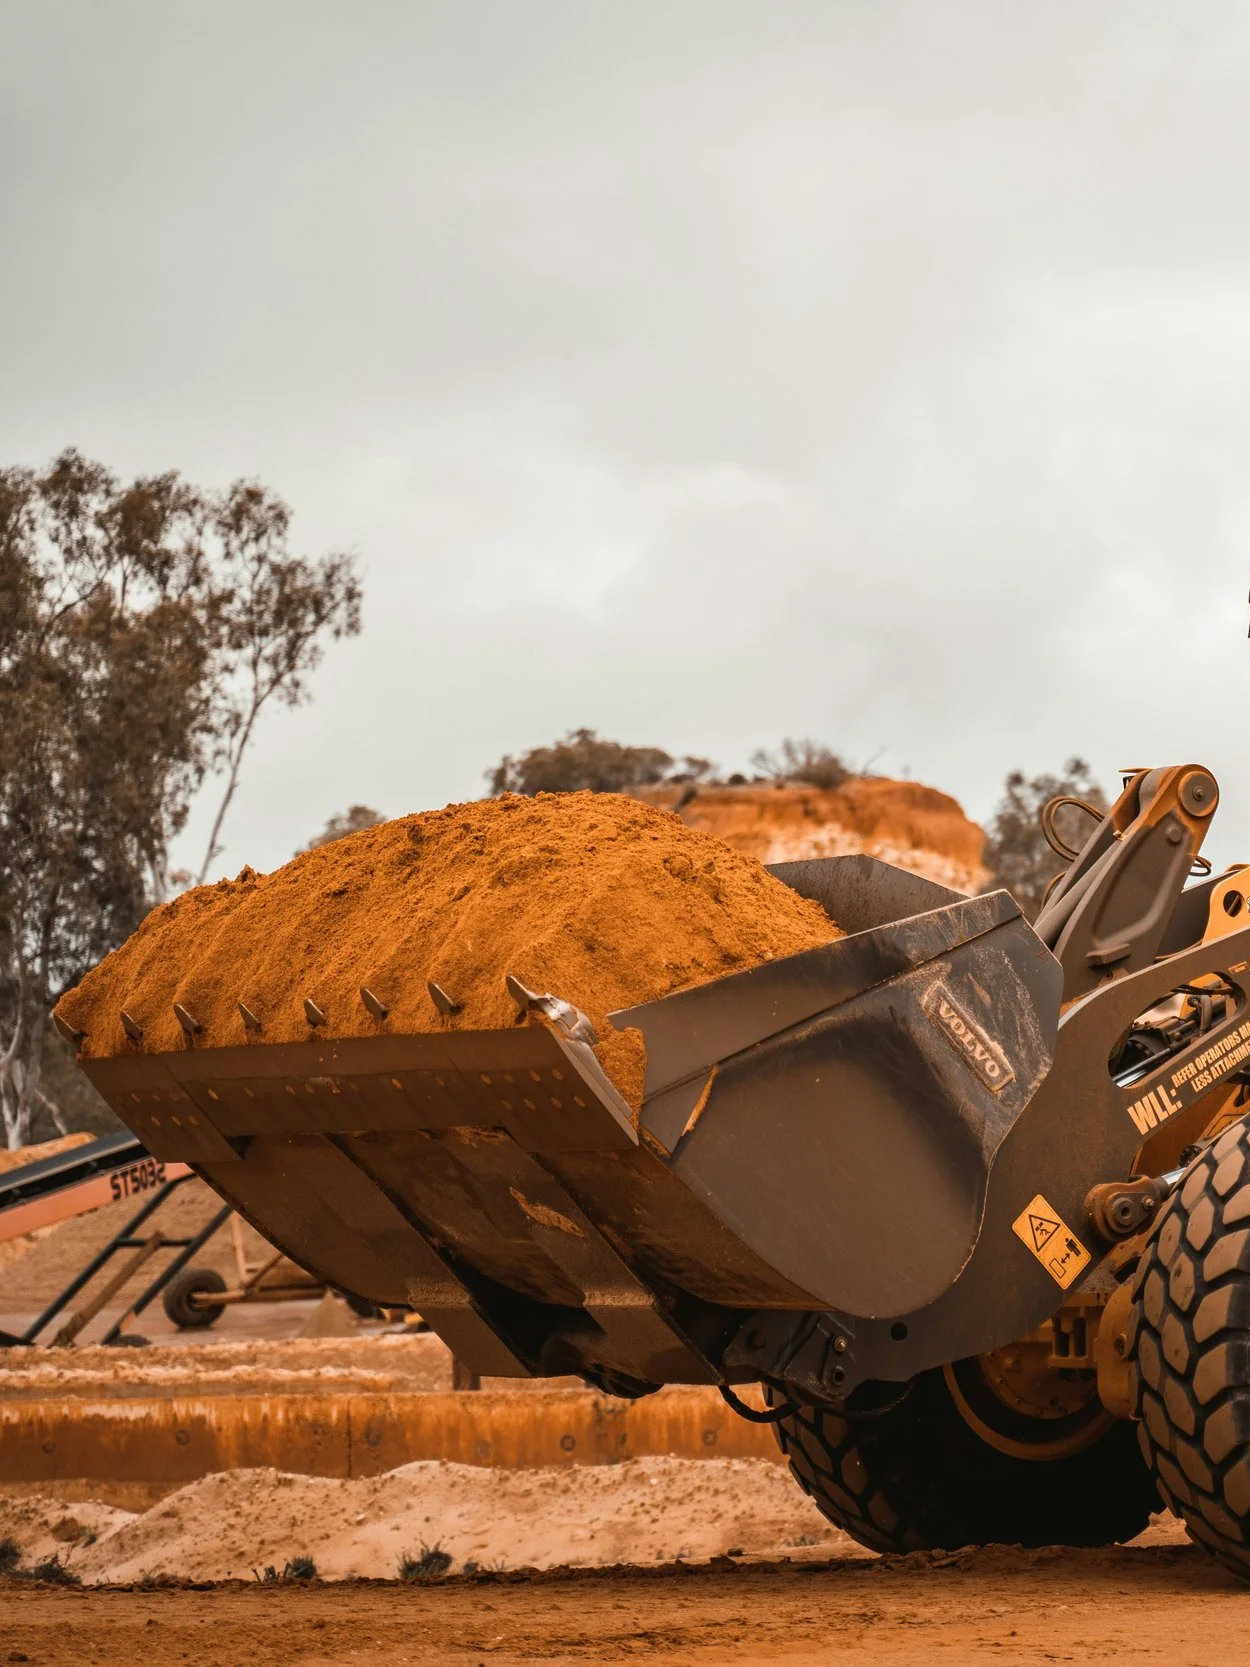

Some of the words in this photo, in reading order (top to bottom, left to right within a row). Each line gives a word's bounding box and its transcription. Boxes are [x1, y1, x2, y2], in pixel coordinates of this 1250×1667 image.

[938, 996, 1001, 1078] VOLVO
[1171, 1062, 1197, 1088] REFER
[1195, 1031, 1242, 1071] OPERATORS
[1191, 1070, 1215, 1093] LESS
[1126, 1084, 1183, 1136] WLL:
